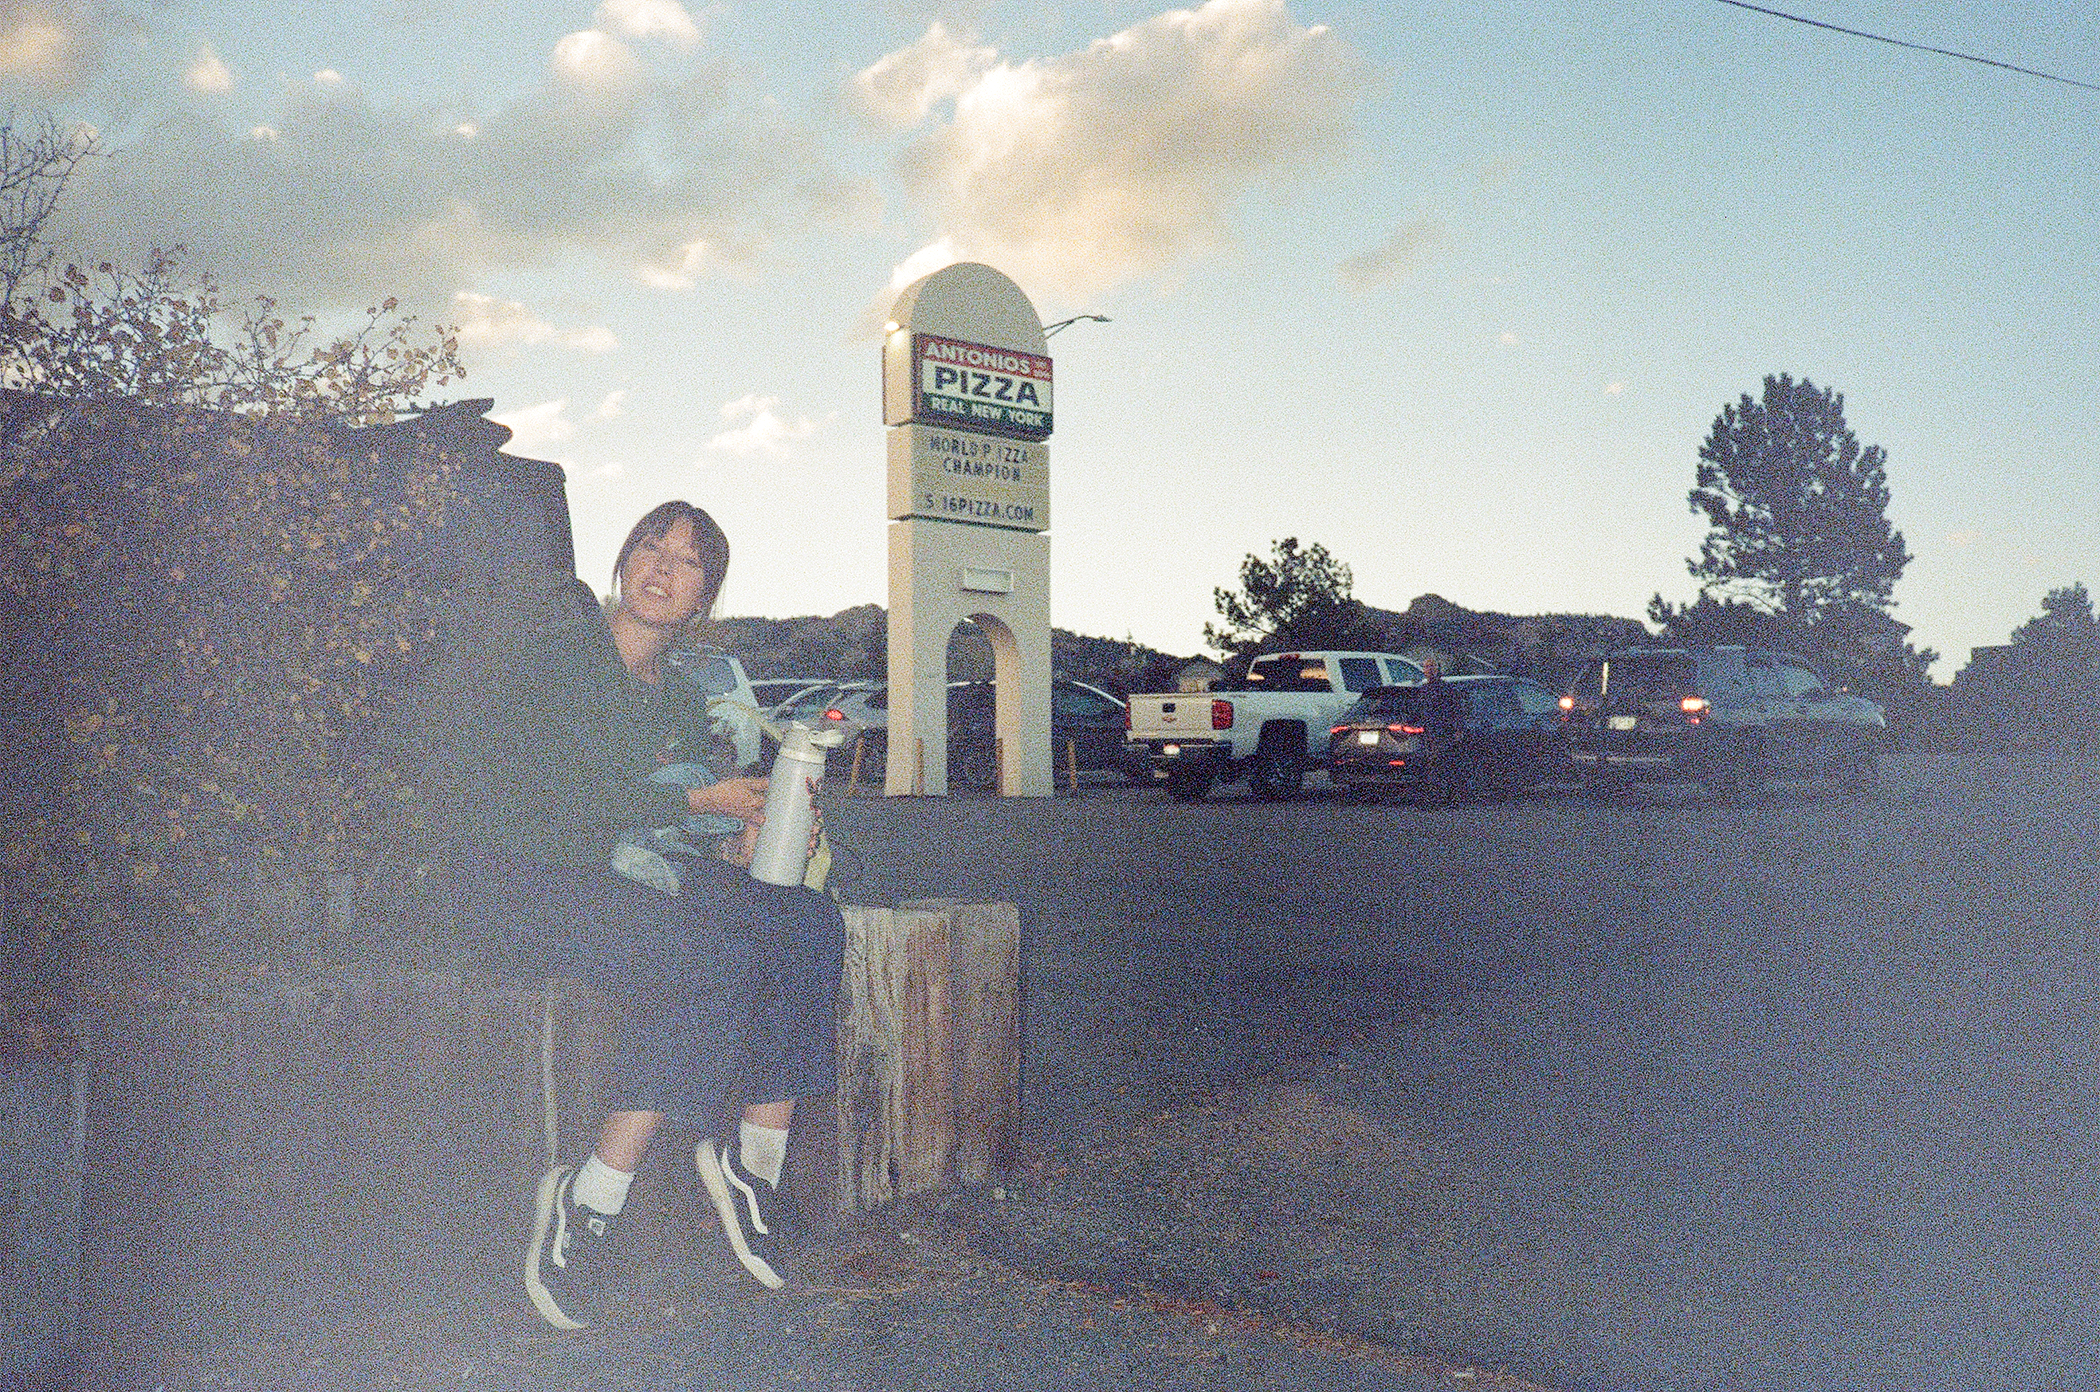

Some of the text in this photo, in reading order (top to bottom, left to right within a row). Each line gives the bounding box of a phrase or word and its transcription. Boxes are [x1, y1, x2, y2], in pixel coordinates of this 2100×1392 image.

[925, 342, 1031, 374] ANTONIOS
[935, 366, 1039, 407] PIZZA
[931, 397, 1044, 427] REAL NEW YORK
[929, 435, 978, 457] WORLD
[943, 457, 1021, 482] CHAMPION
